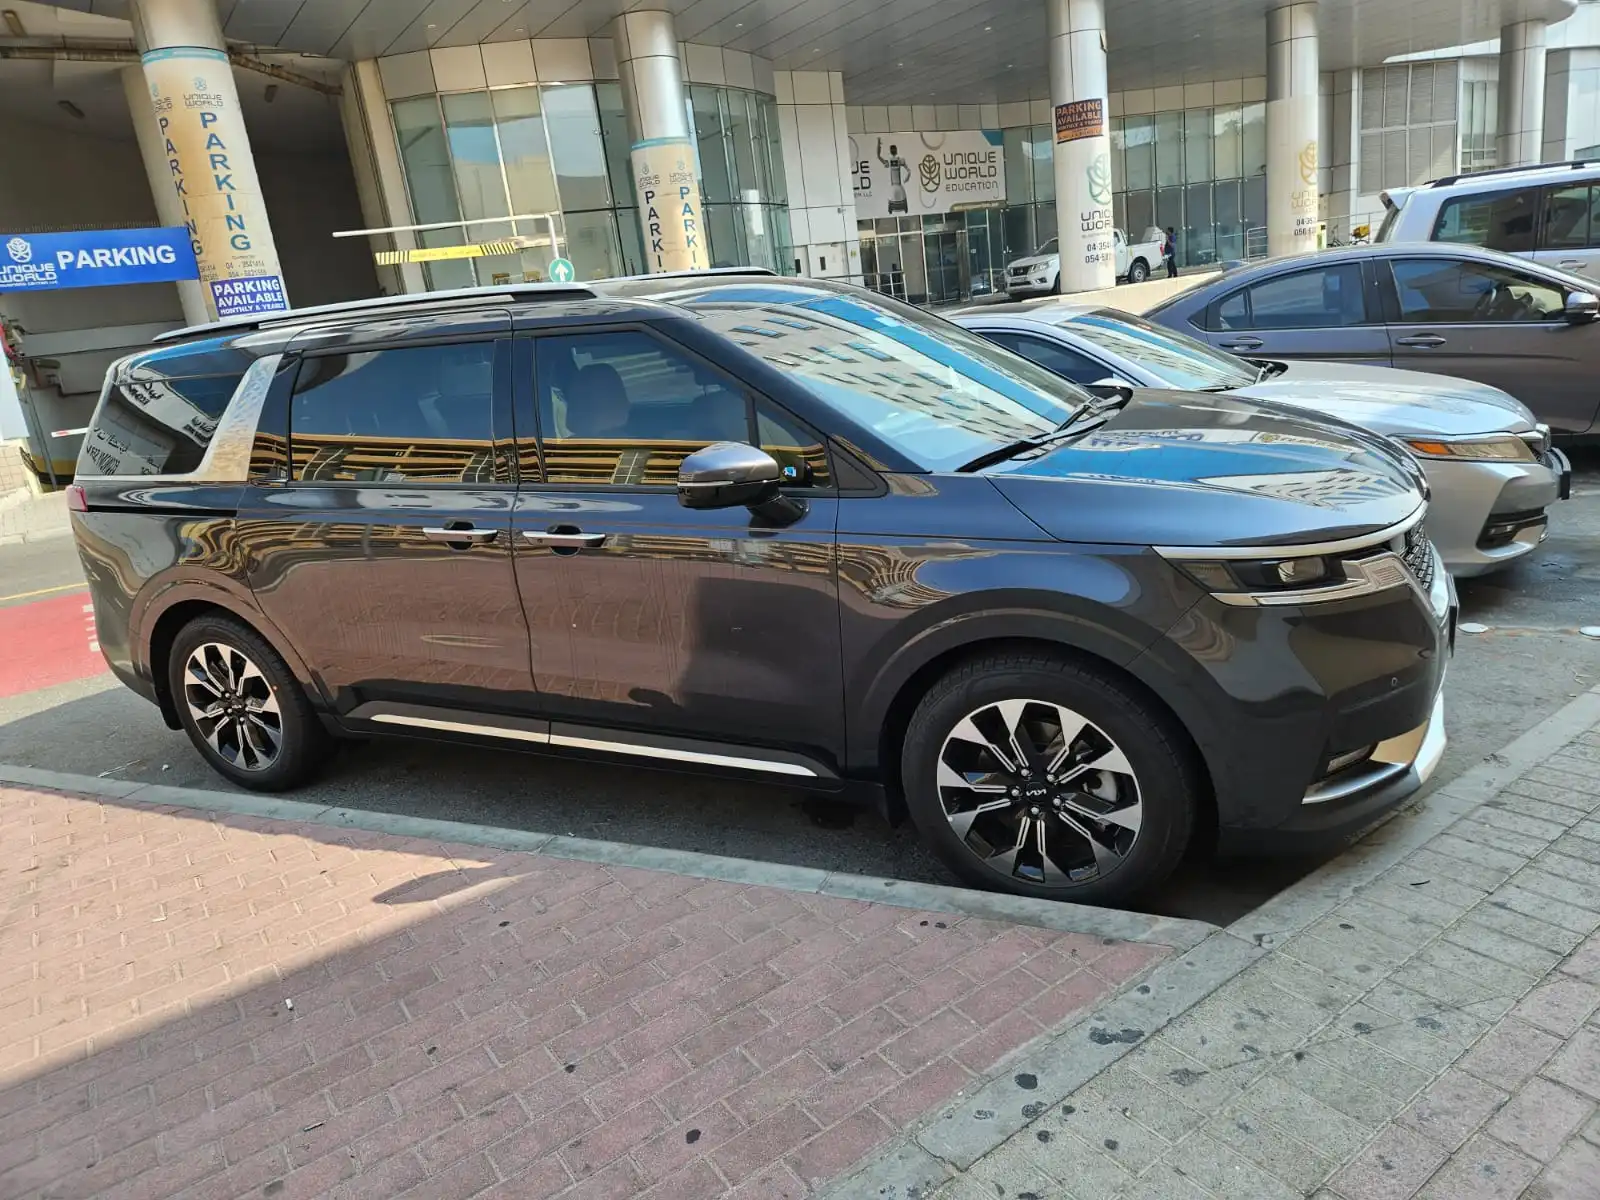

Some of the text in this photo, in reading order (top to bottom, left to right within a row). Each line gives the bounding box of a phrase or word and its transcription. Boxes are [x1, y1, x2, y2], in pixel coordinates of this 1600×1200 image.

[1056, 101, 1102, 119] PARKING
[1058, 111, 1102, 127] AVAILABLE
[943, 151, 997, 166] UNIQUE
[200, 111, 251, 250] PARKING
[944, 165, 998, 180] WORLD
[945, 180, 999, 192] EDUCATION
[645, 190, 667, 273] PARKI
[679, 186, 701, 271] PARKI
[1081, 219, 1111, 231] WOR
[56, 245, 176, 270] PARKING
[0, 263, 55, 275] UNIQUE
[0, 272, 57, 283] WORLD
[213, 279, 281, 296] PARKING
[218, 291, 284, 308] AVAILABLE
